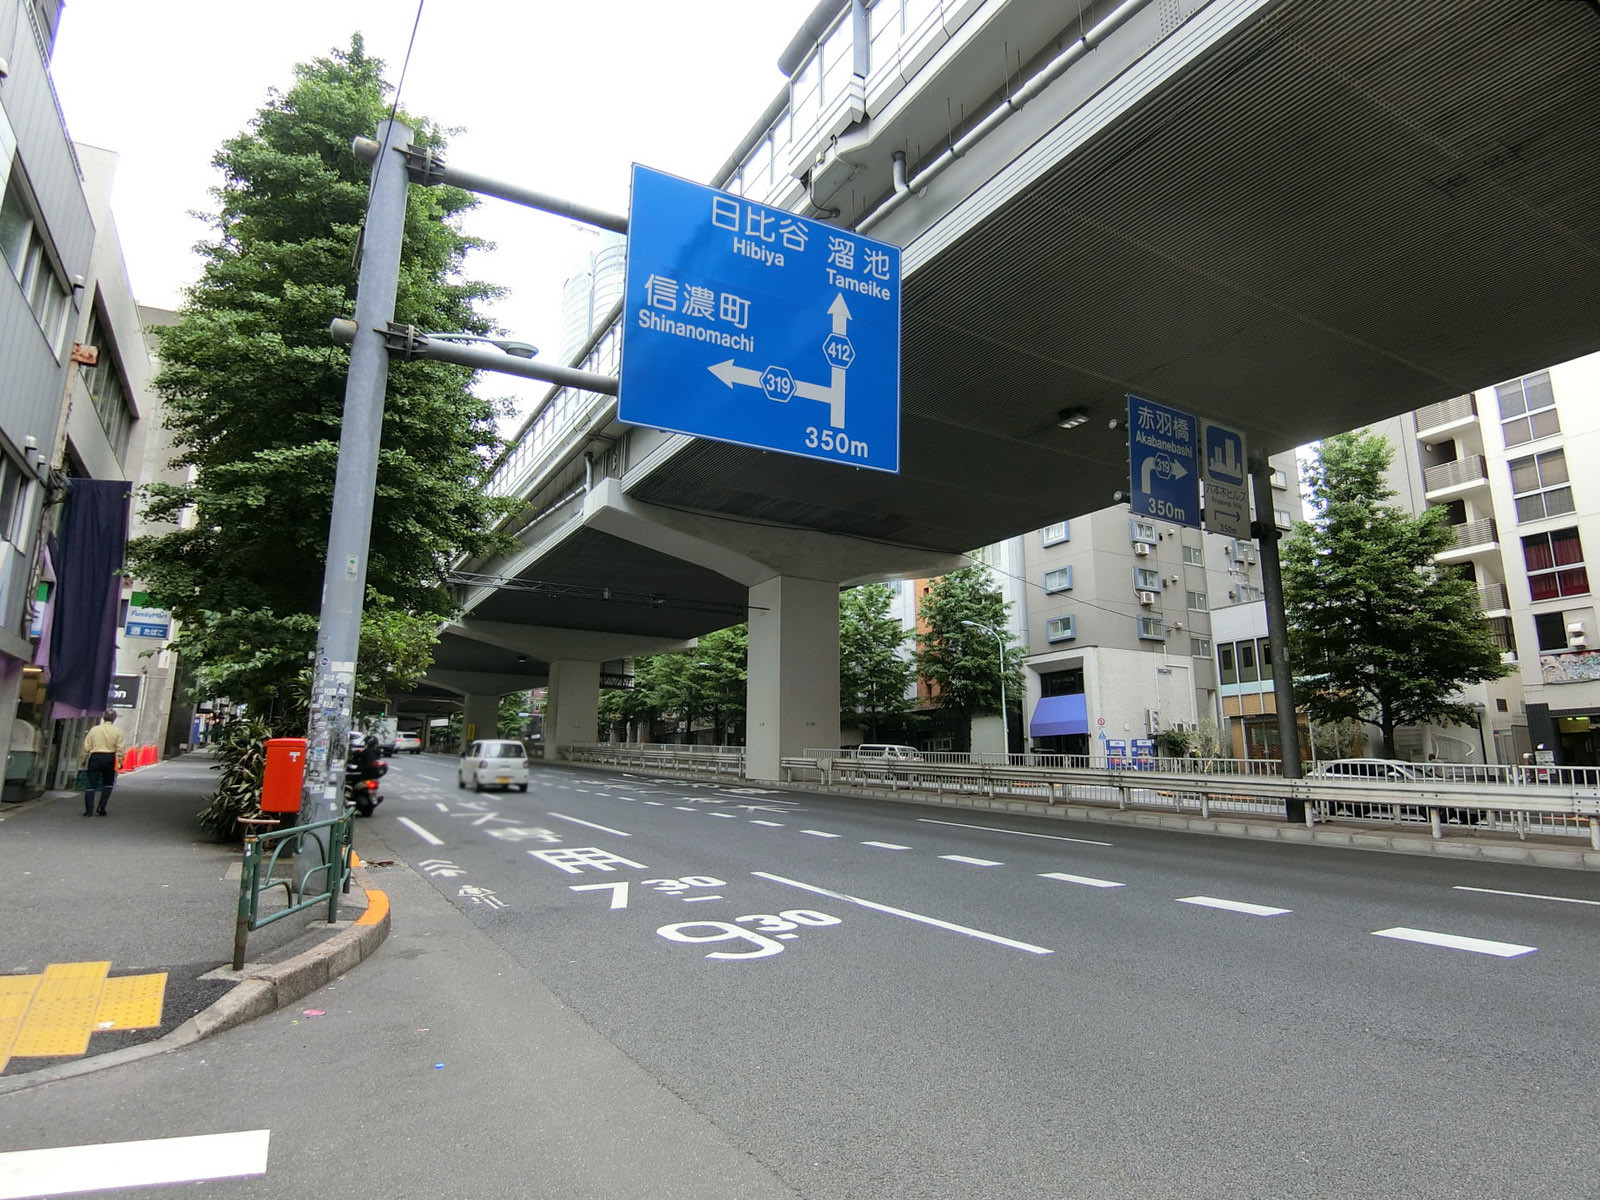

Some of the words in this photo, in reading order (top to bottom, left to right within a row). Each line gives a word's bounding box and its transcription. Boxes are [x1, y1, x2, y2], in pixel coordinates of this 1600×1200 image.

[712, 196, 808, 252] 日比谷
[733, 237, 785, 267] Hibiya
[826, 235, 890, 281] 溜池
[826, 268, 891, 301] Tameike
[644, 273, 752, 330] 信濃町
[638, 309, 755, 353] Shinanomachi
[827, 342, 850, 362] 412
[766, 373, 790, 395] 319
[1137, 405, 1190, 443] 赤羽橋
[805, 426, 869, 459] 350m
[1135, 431, 1193, 459] Akabanebashi
[1156, 458, 1170, 474] 319
[1148, 498, 1185, 521] 350m
[1219, 523, 1238, 536] 350m
[130, 609, 168, 620] FamilyMart
[143, 628, 164, 637] たばこ
